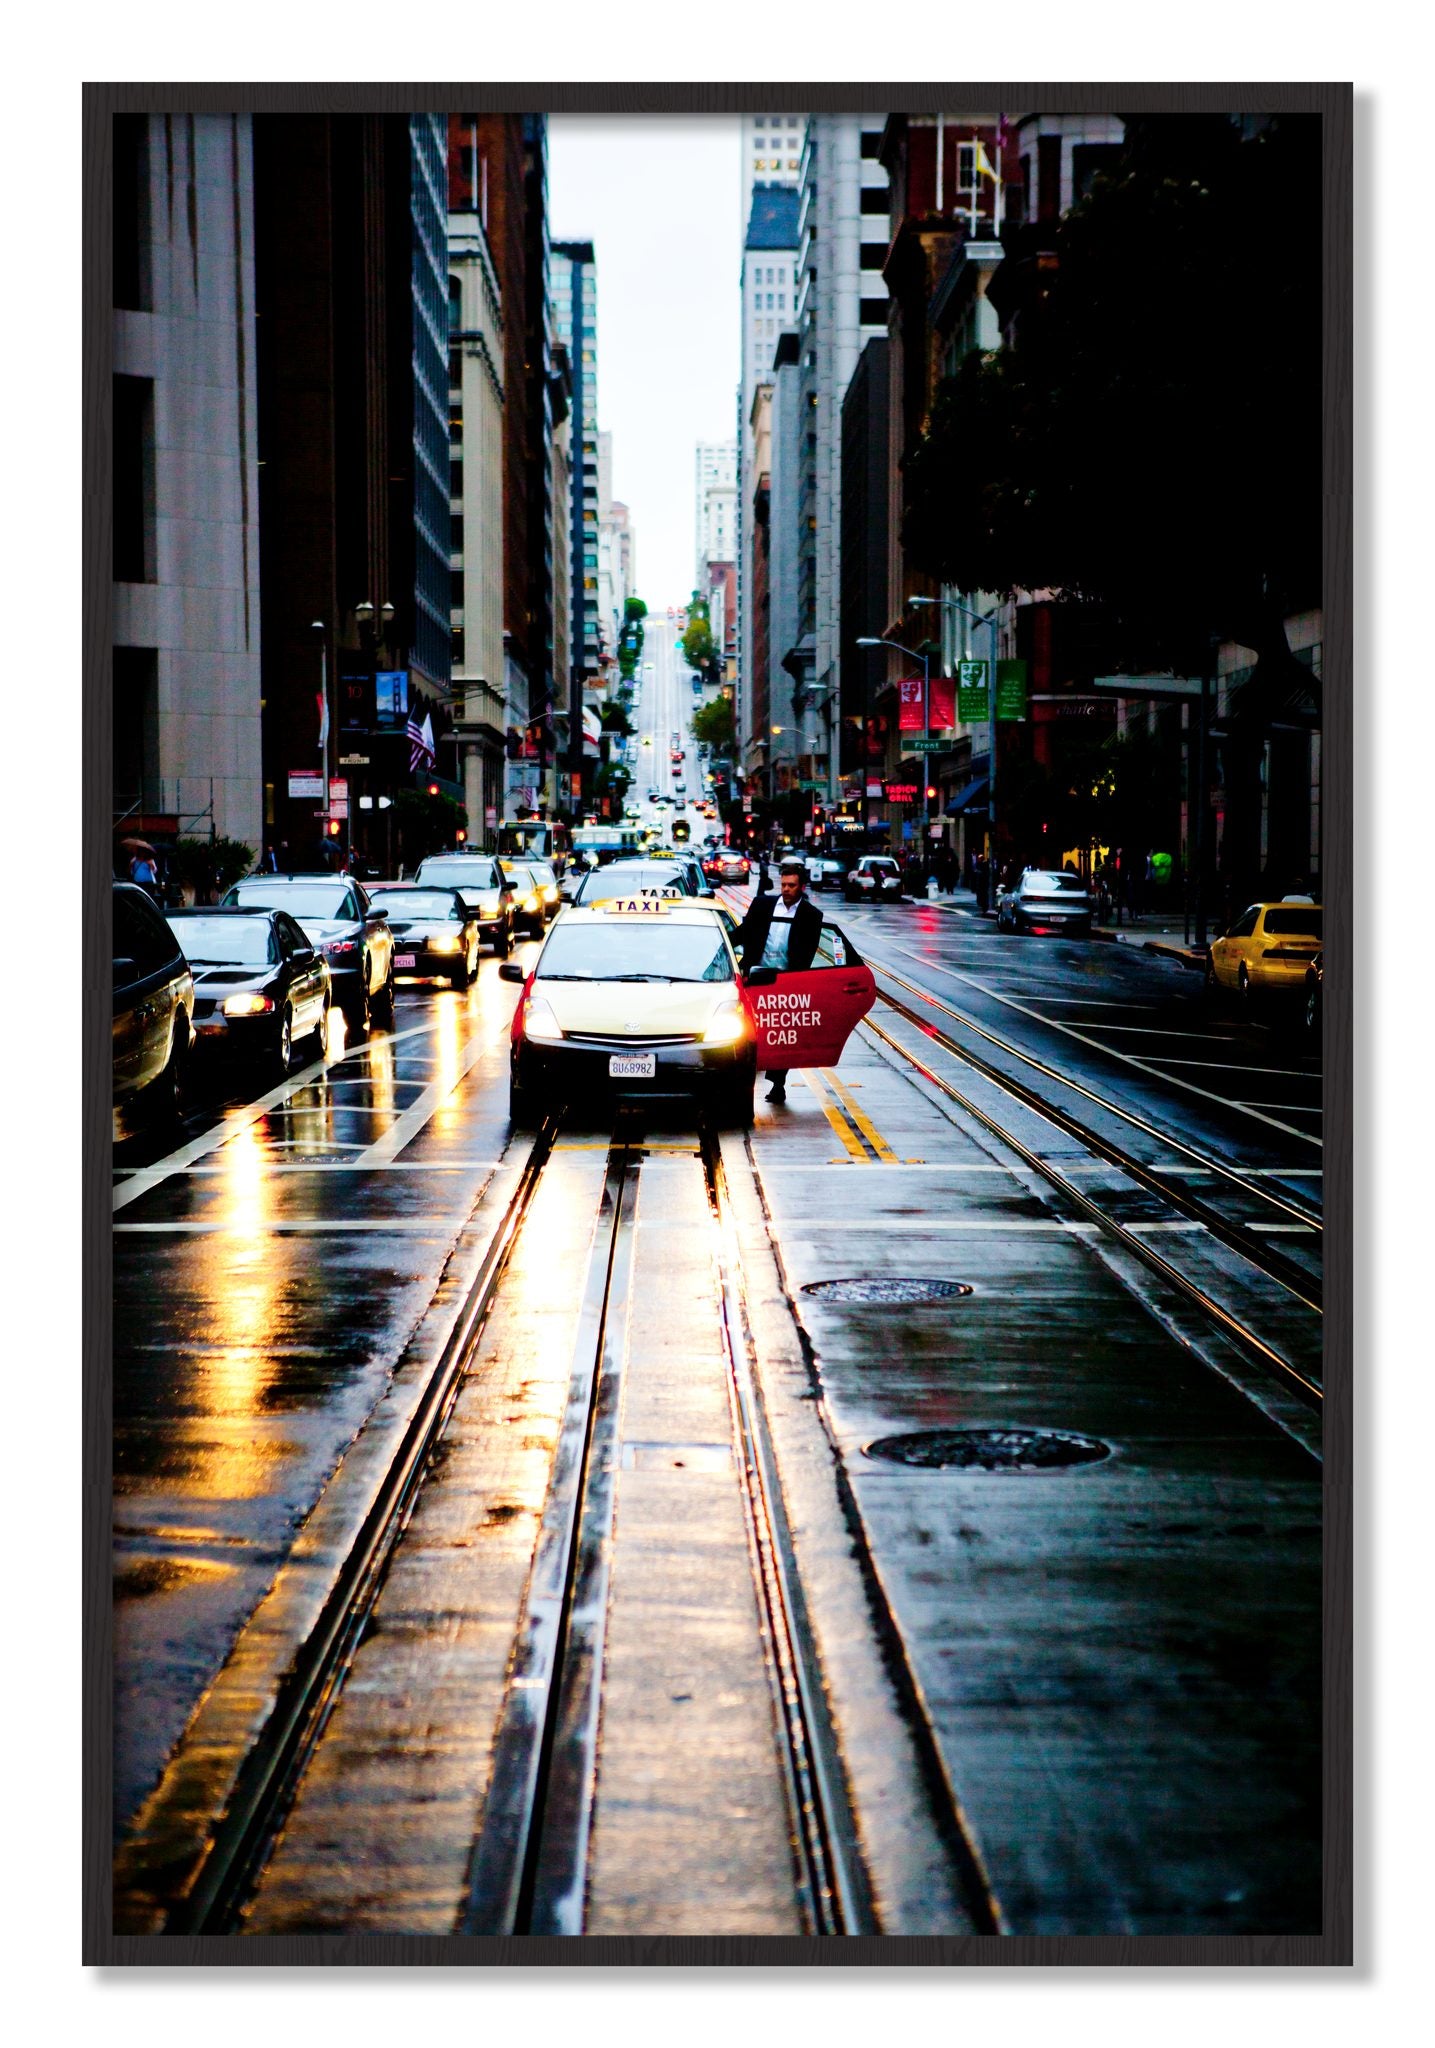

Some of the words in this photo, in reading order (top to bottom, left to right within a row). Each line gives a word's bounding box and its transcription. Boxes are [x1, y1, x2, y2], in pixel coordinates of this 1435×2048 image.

[347, 687, 363, 699] 10
[885, 785, 918, 794] TADICH
[889, 794, 914, 802] GRILL
[641, 889, 676, 898] TAXI
[616, 901, 660, 912] TAXI
[757, 993, 811, 1010] ARROW
[766, 1030, 797, 1046] CAB
[612, 1062, 652, 1074] 8U68982
